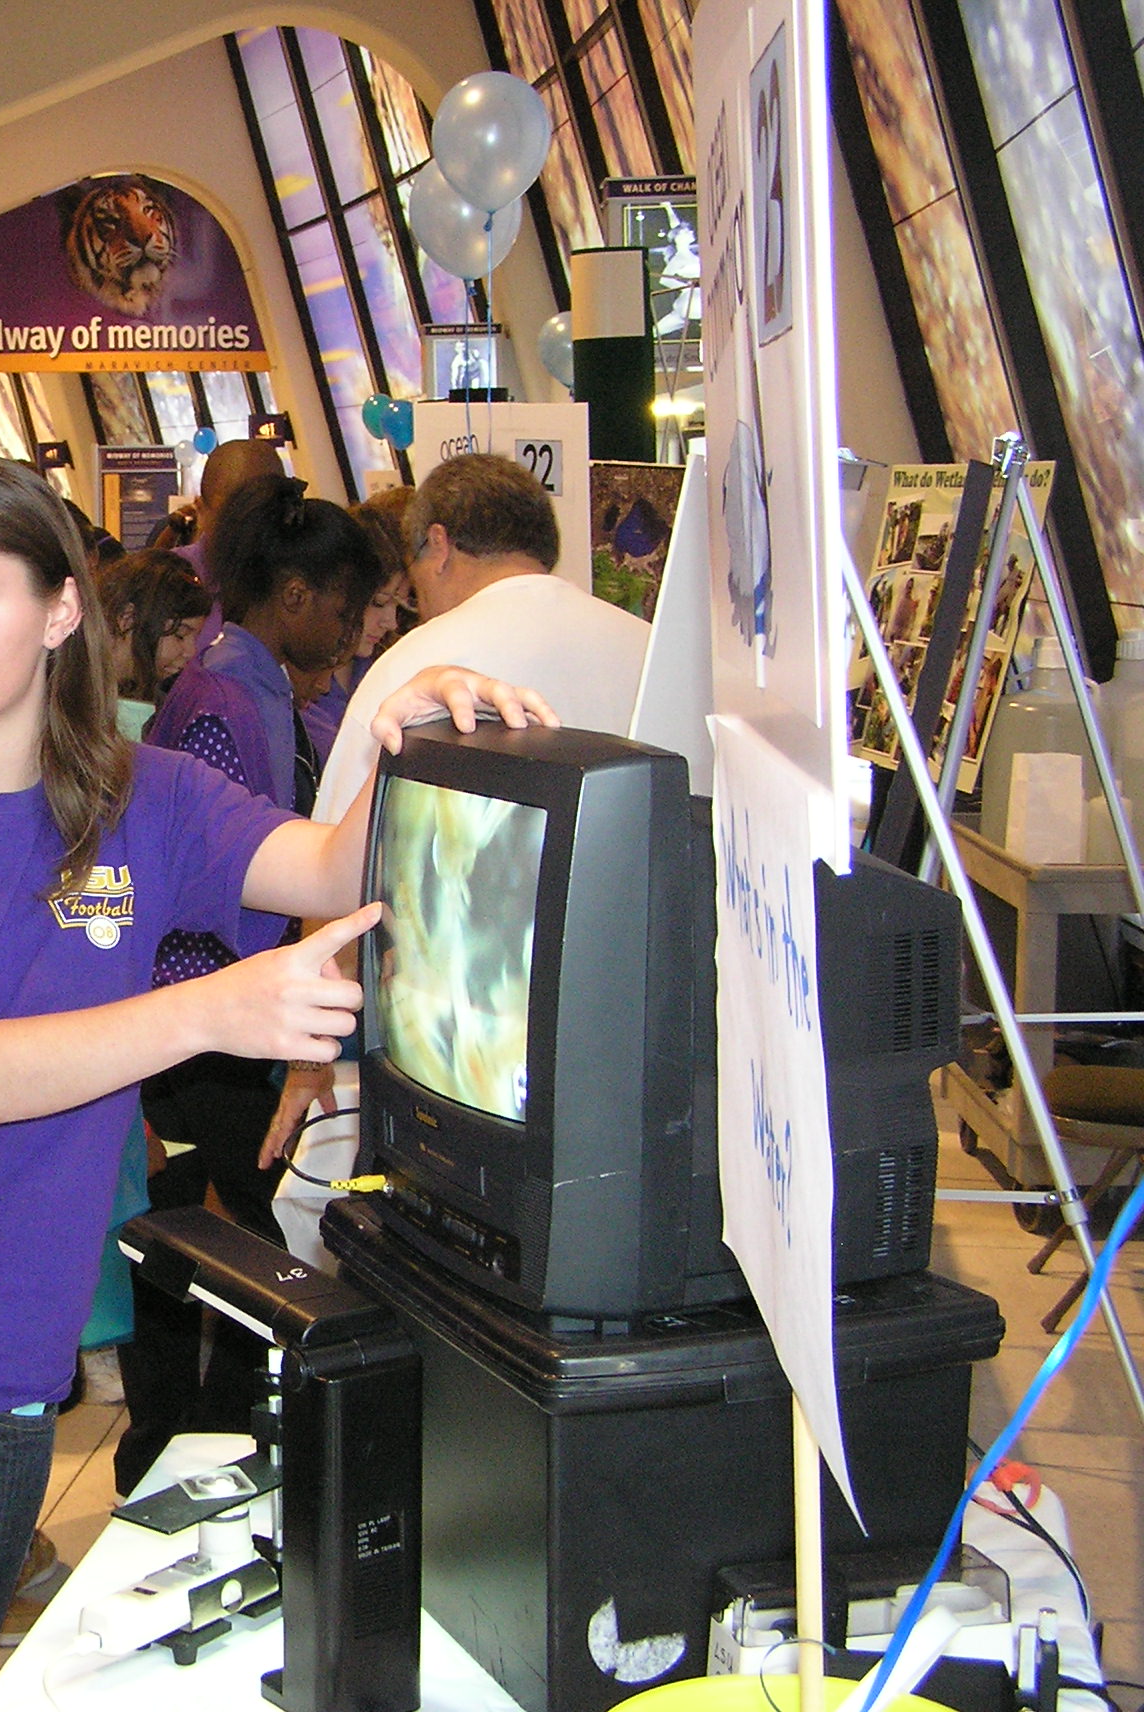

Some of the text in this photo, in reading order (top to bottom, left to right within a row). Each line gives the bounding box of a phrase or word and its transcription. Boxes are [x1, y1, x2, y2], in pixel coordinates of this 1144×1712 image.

[622, 182, 651, 193] WALK
[653, 182, 667, 192] OF
[757, 57, 784, 325] 23
[71, 316, 102, 350] of
[107, 316, 250, 350] memories
[85, 360, 251, 371] MARAVICH CENTER
[523, 444, 554, 491] 22
[893, 471, 918, 488] What
[920, 471, 932, 488] do
[935, 471, 966, 488] Wetla
[1029, 469, 1050, 487] do?
[61, 865, 132, 890] SU
[64, 896, 134, 917] Football
[782, 863, 811, 1032] the
